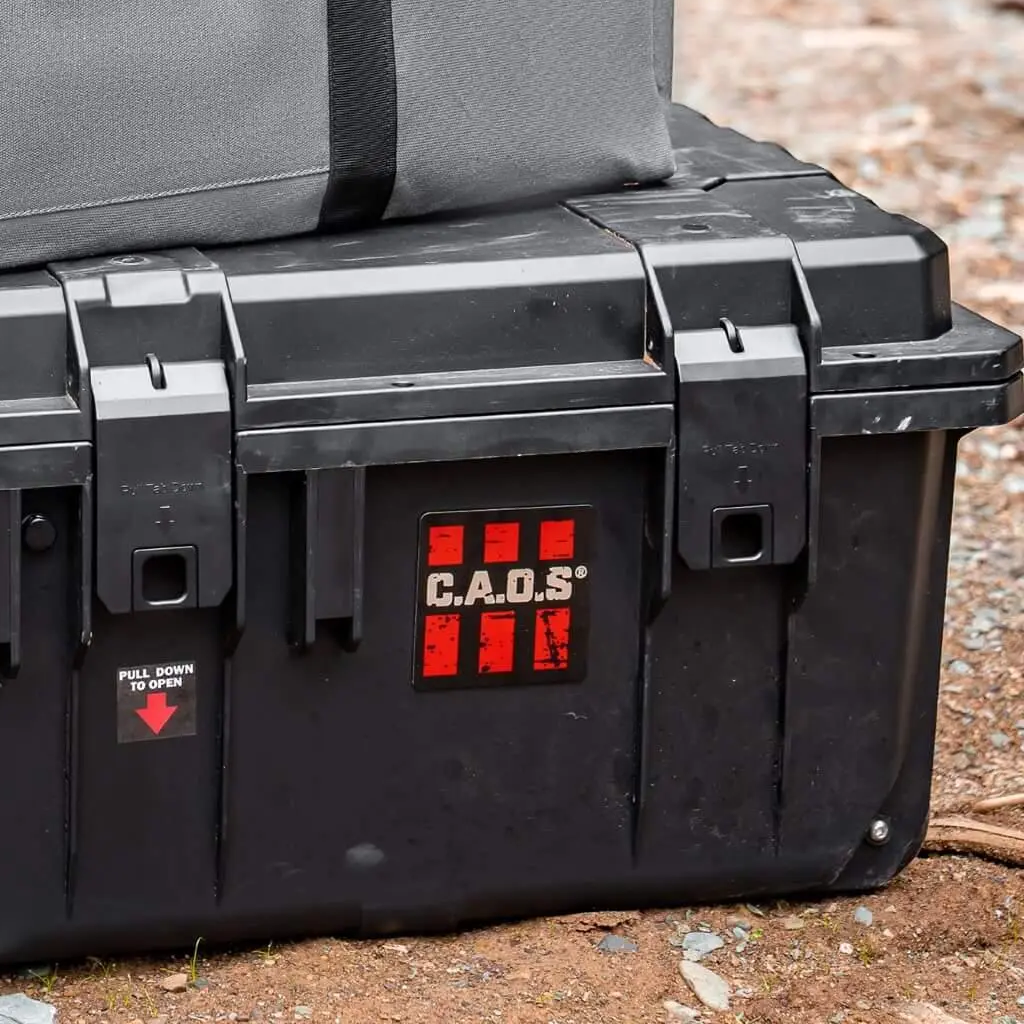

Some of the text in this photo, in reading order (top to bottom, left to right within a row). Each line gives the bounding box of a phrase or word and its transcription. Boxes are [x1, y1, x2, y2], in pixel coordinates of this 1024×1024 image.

[119, 664, 194, 681] PULL DOWN
[130, 677, 183, 691] TO OPEN
